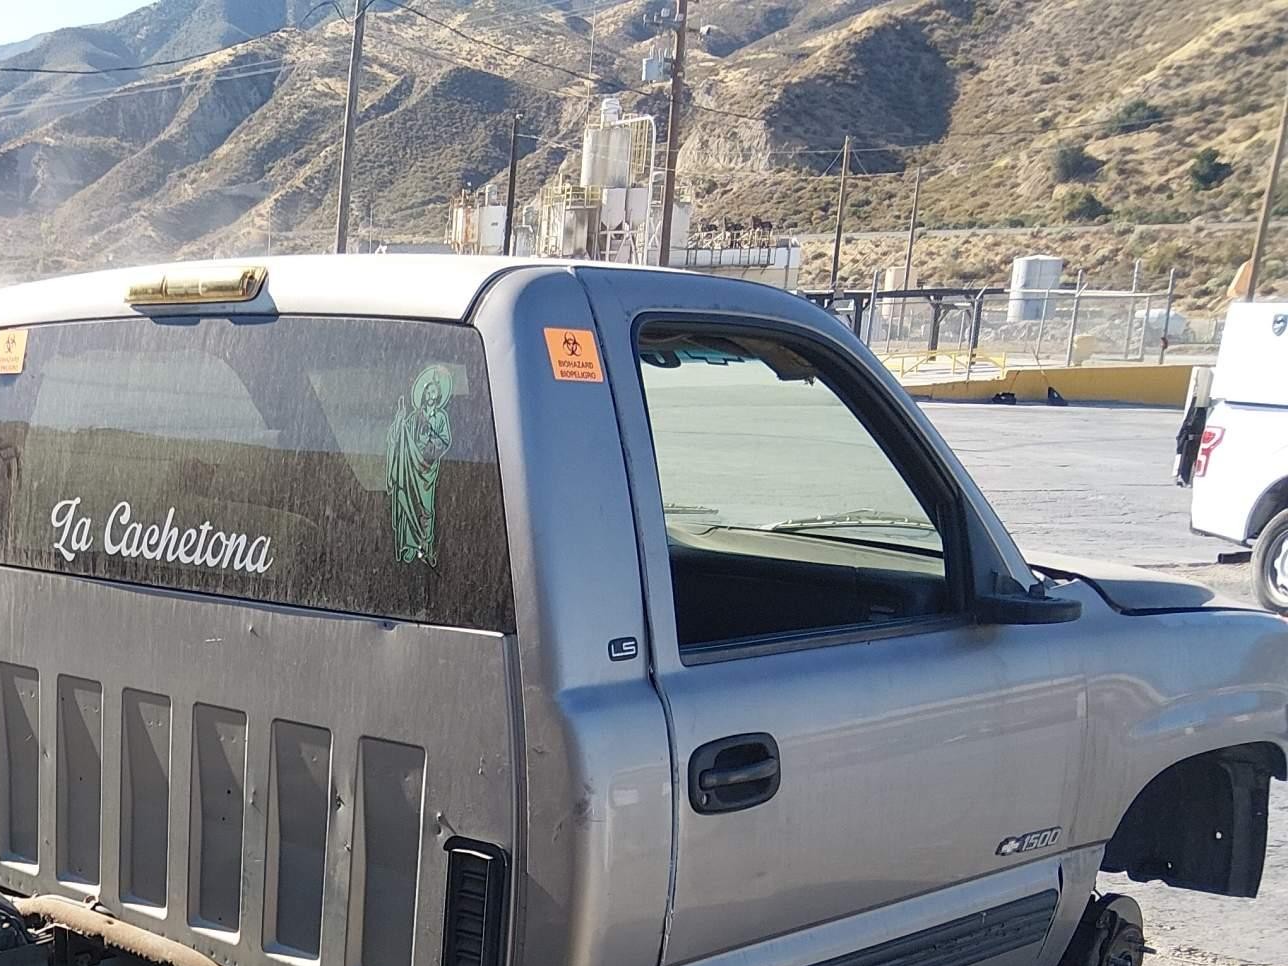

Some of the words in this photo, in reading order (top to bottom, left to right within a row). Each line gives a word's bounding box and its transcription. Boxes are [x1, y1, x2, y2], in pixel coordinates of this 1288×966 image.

[557, 360, 594, 369] BIOHAZARD
[559, 370, 597, 380] BIOPELIGRO
[51, 497, 94, 562] La
[104, 501, 274, 574] Cachetona
[611, 641, 636, 657] LS
[1022, 829, 1062, 851] 1500
